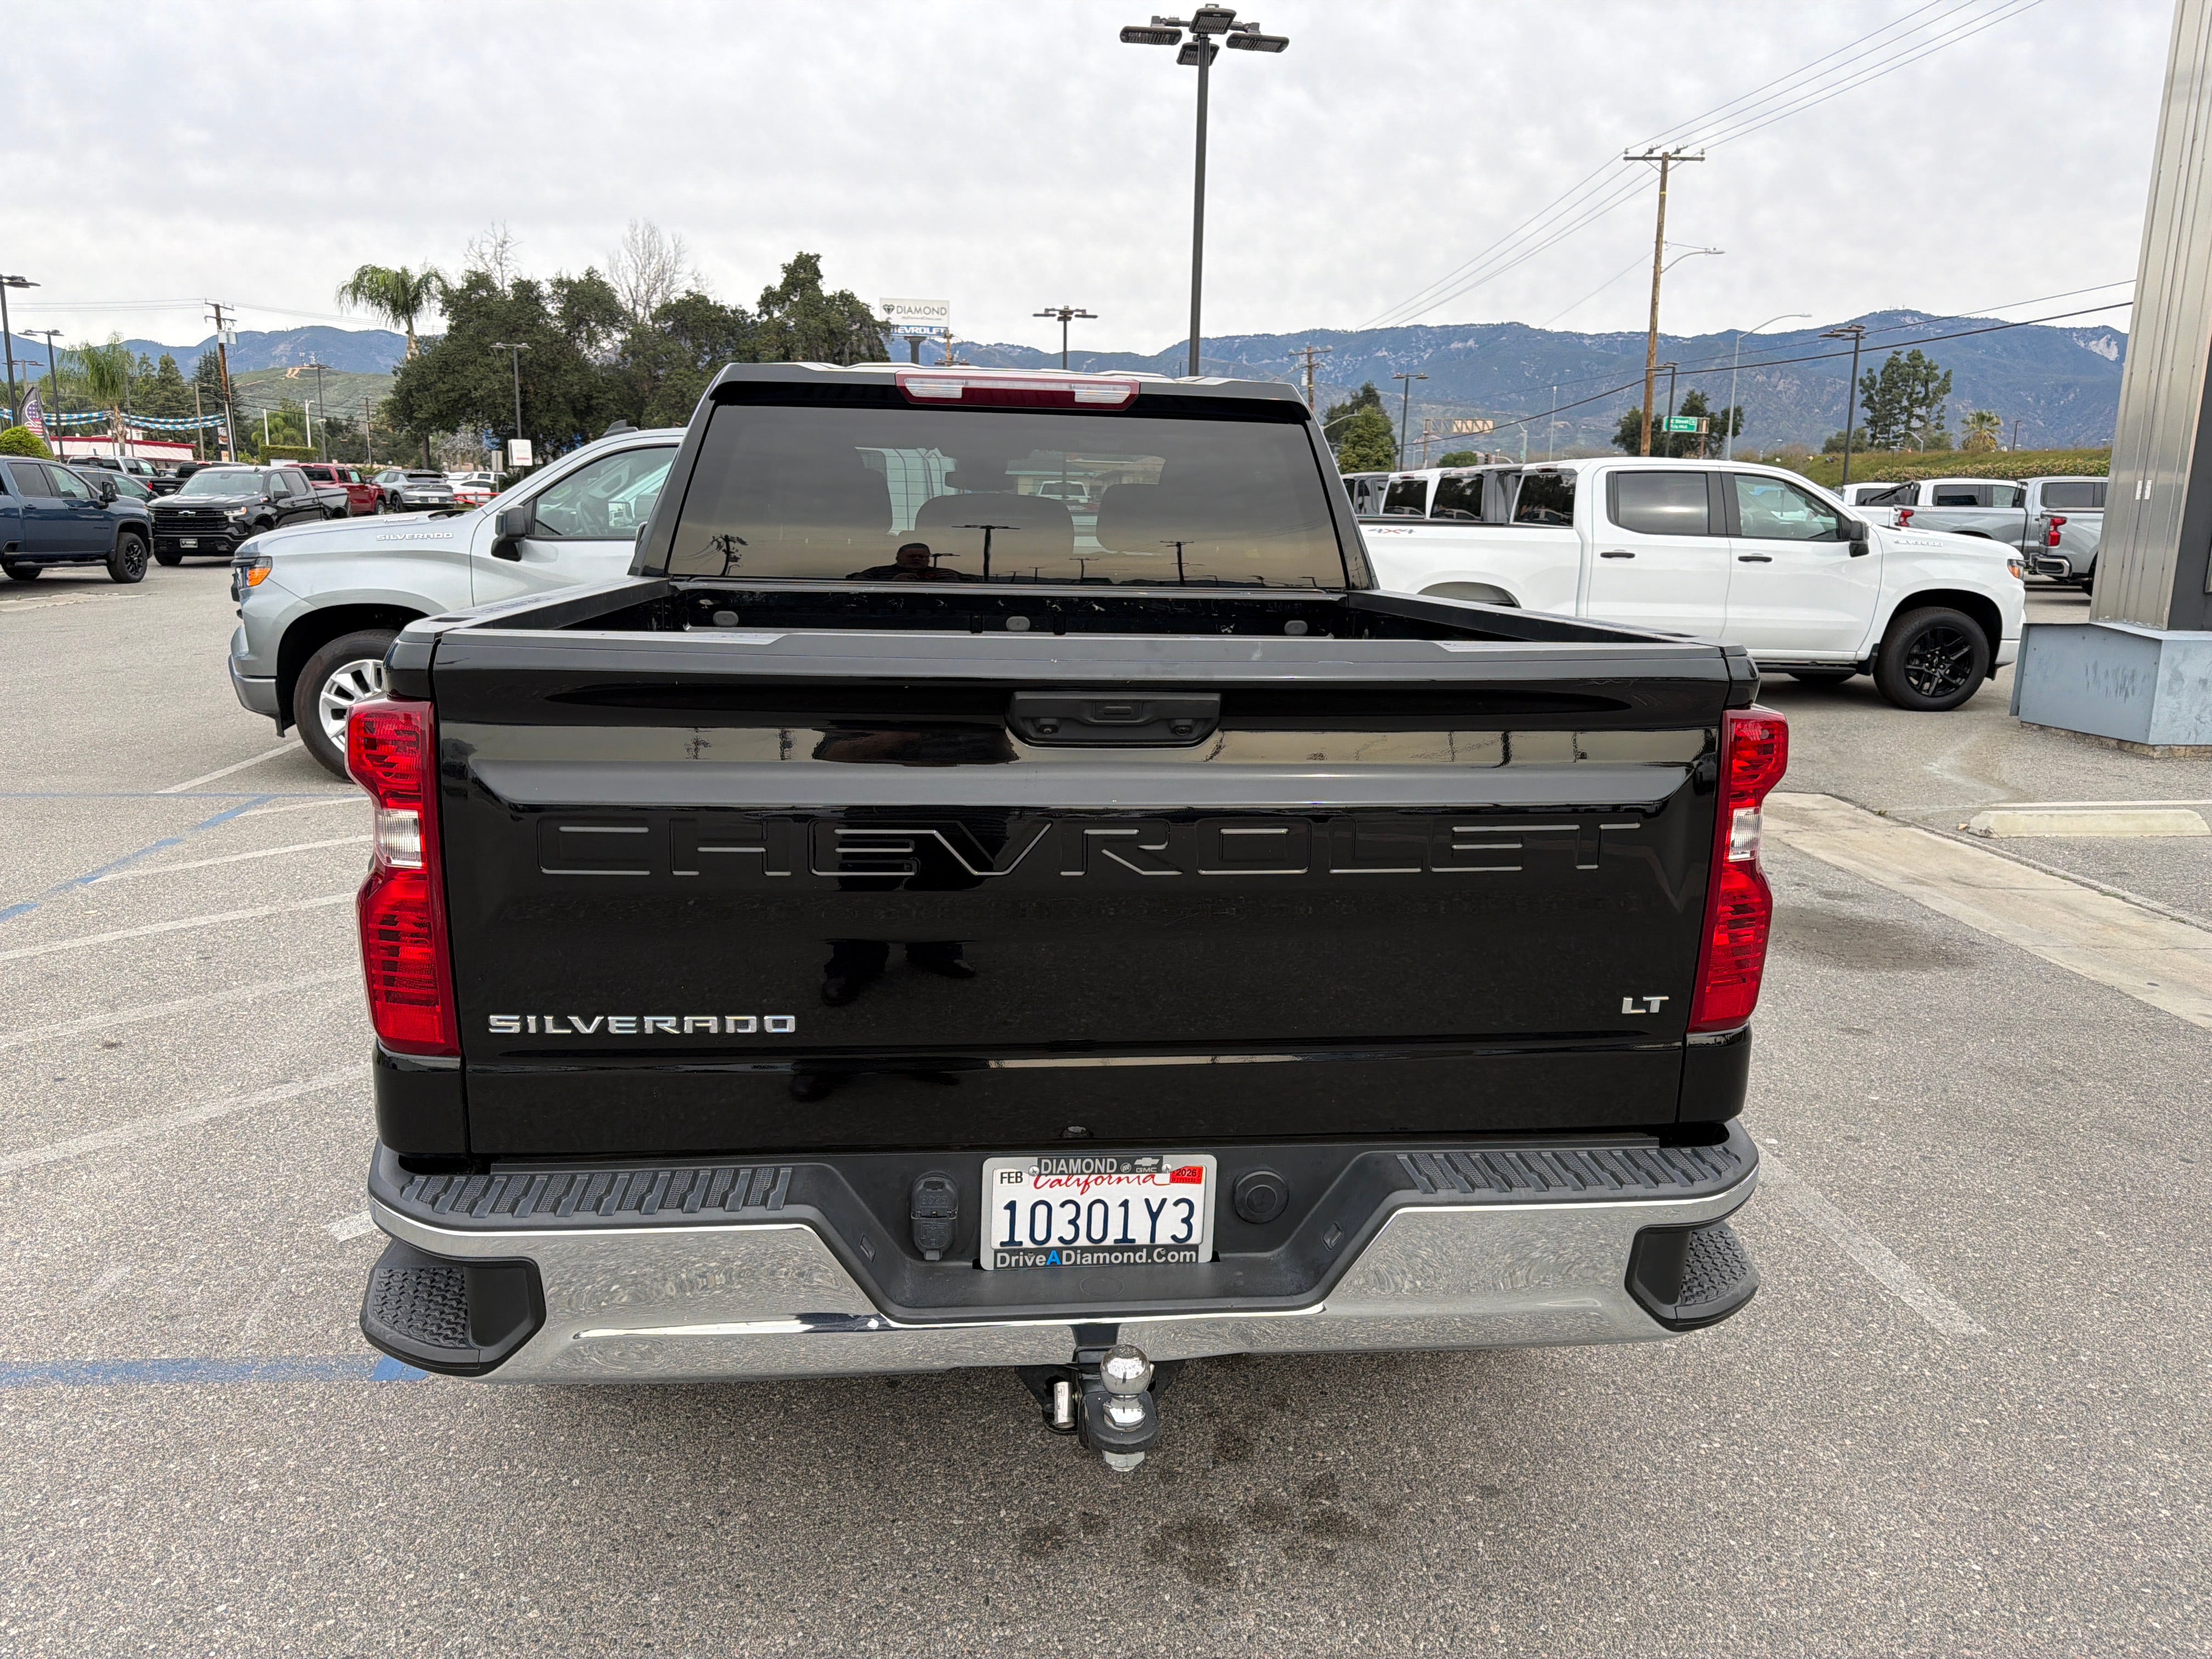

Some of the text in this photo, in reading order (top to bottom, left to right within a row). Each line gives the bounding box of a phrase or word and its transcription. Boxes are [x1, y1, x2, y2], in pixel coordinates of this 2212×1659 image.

[896, 305, 947, 315] DIAMOND
[889, 326, 946, 335] HEVROLET
[376, 532, 453, 541] SILVERADO
[537, 816, 1641, 877] CHEVROLET
[1621, 996, 1669, 1014] LT
[488, 1015, 796, 1035] SILVERADO
[1040, 1158, 1117, 1175] DIAMOND
[1000, 1168, 1197, 1196] FEB California 2026
[999, 1197, 1195, 1248] 10301Y3
[996, 1248, 1197, 1268] DriveADiamond.Com
